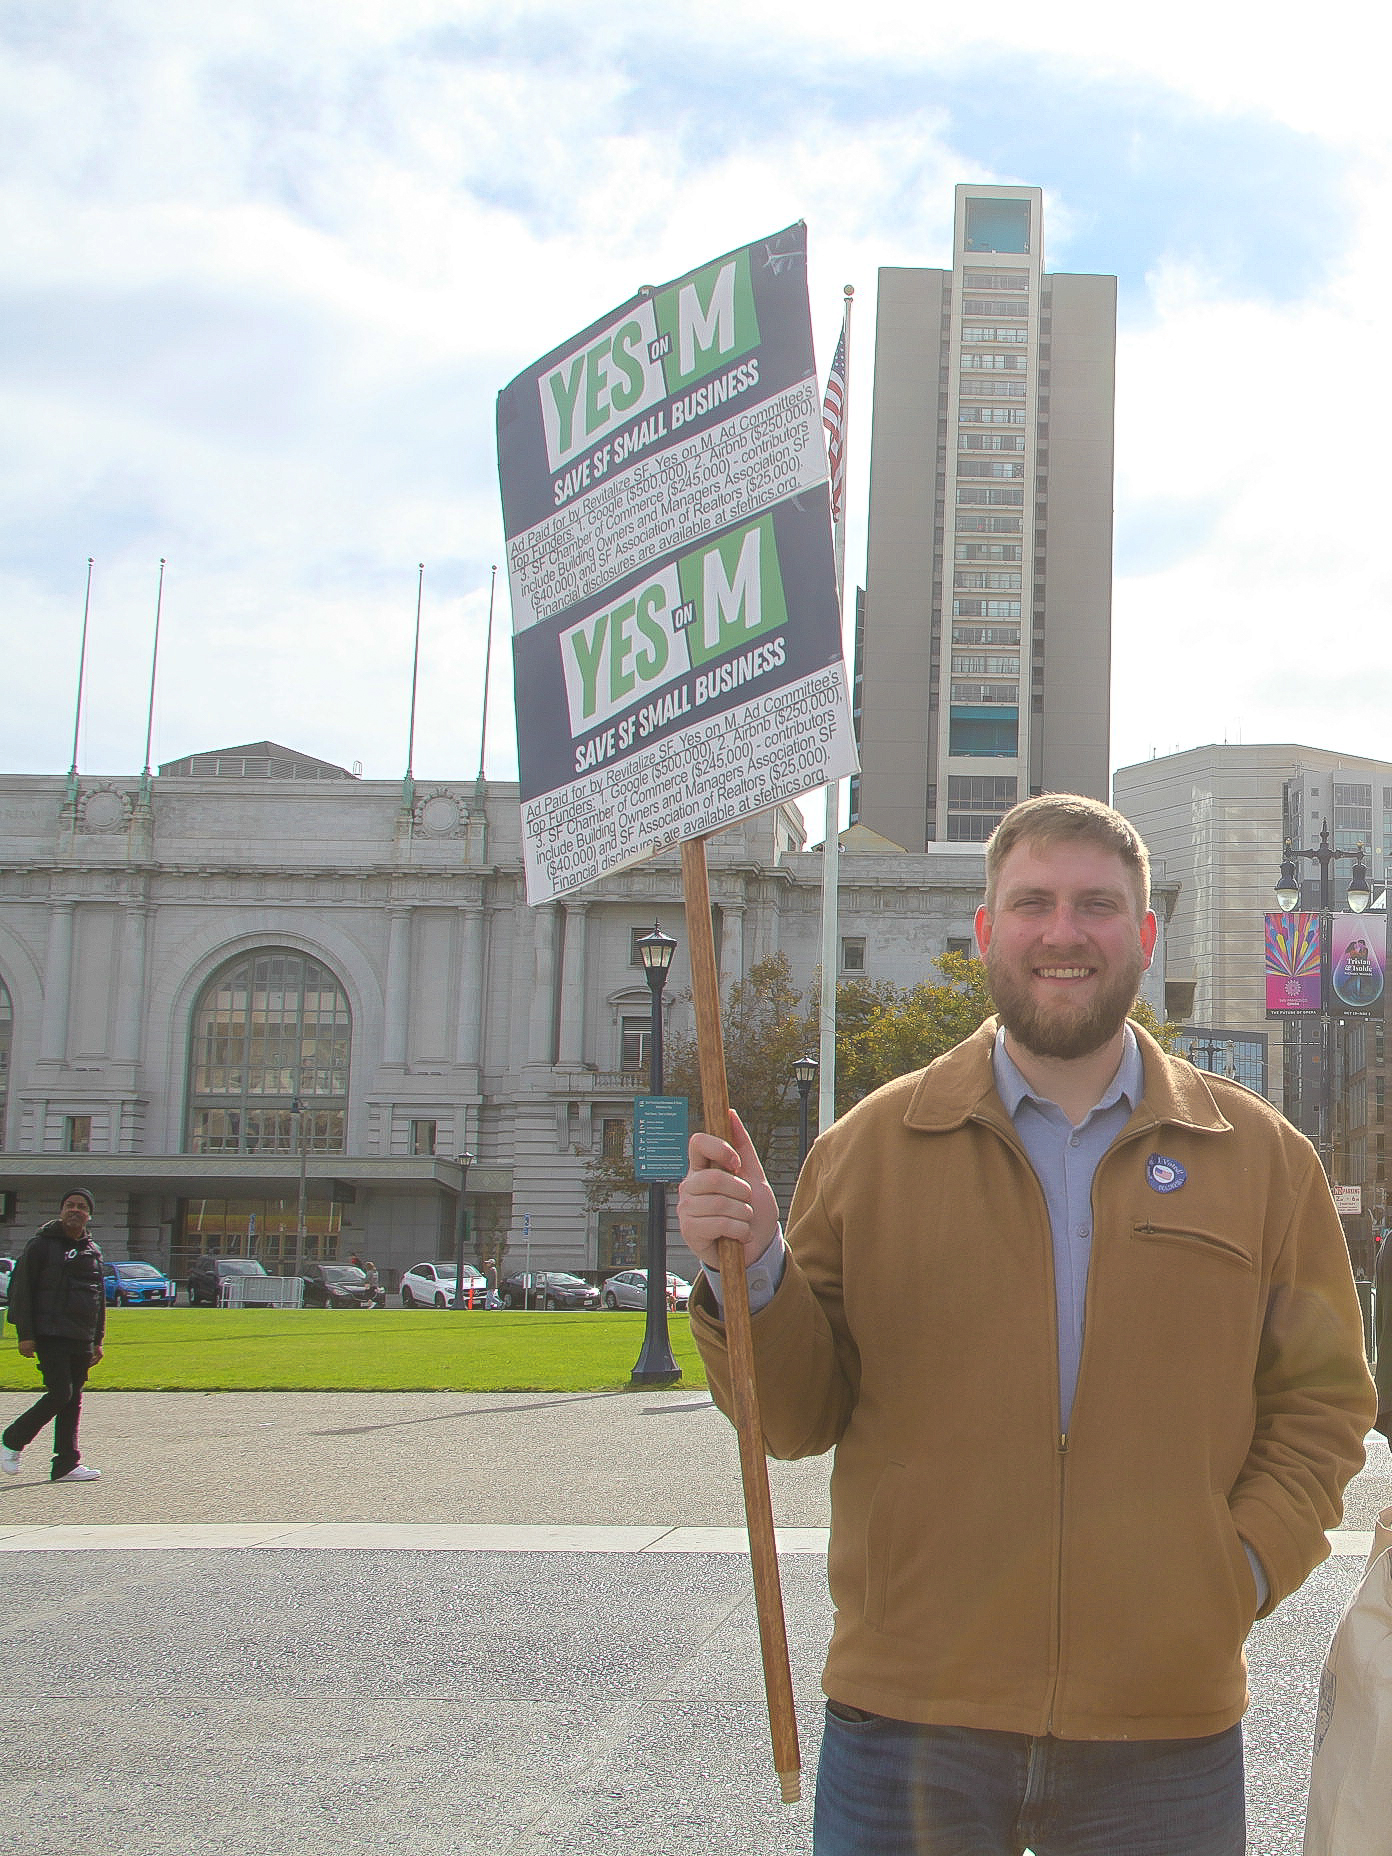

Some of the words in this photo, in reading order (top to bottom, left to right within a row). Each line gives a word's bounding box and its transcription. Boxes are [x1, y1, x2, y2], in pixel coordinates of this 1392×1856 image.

[549, 320, 645, 455] YES
[651, 336, 669, 361] ON
[679, 261, 737, 377] M
[554, 466, 591, 506] SAVE
[593, 447, 613, 478] SF
[614, 422, 668, 463] SMALL
[671, 359, 759, 431] BUSINESS
[572, 583, 668, 720] YES
[675, 604, 694, 627] ON
[704, 527, 764, 649] M
[526, 800, 541, 820] Ad
[544, 788, 568, 812] Paid
[571, 781, 586, 800] for
[589, 774, 603, 795] by
[605, 749, 656, 785] Revitalize
[679, 727, 701, 750] Yes
[705, 722, 721, 739] on
[742, 702, 760, 723] Ad
[575, 733, 617, 773] SAVE
[619, 718, 639, 750] SF
[639, 690, 691, 740] SMALL
[696, 636, 786, 703] BUSINESS
[527, 815, 546, 836] Top
[548, 794, 595, 827] Funders:
[610, 770, 649, 801] Google
[732, 715, 771, 745] Airbnb
[535, 835, 573, 865] include
[575, 817, 616, 852] Building
[617, 798, 659, 829] Owners
[661, 788, 682, 810] and
[684, 761, 744, 802] Managers
[745, 730, 815, 774] Association
[818, 721, 838, 743] SF
[548, 824, 563, 843] SF
[566, 802, 613, 836] Chamber
[616, 795, 627, 814] of
[629, 768, 688, 808] Commerce
[763, 705, 835, 749] contributors
[551, 859, 599, 892] Financial
[663, 826, 681, 845] are
[682, 801, 735, 835] available
[737, 796, 750, 812] at
[752, 761, 828, 810] sfethics.org.
[597, 834, 617, 855] and
[619, 825, 636, 845] SF
[637, 797, 700, 838] Association
[702, 790, 715, 809] of
[716, 769, 766, 803] Realtors
